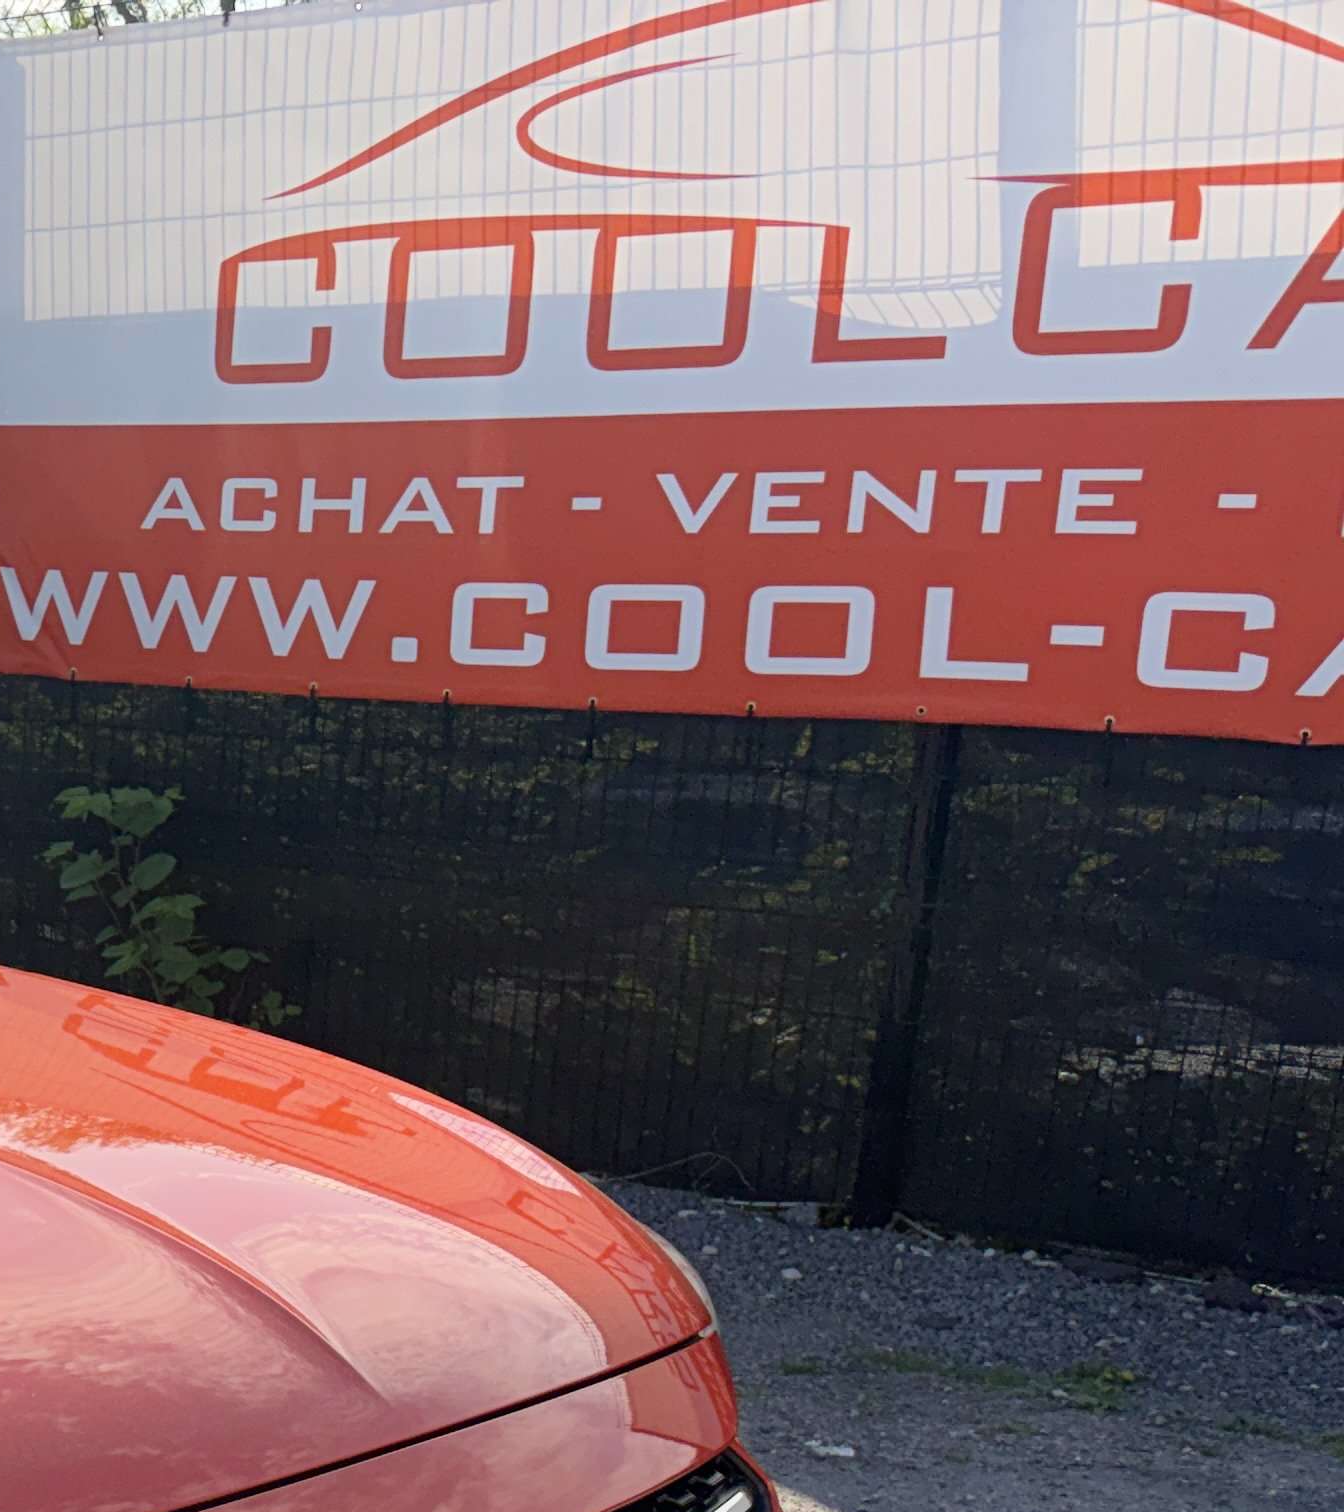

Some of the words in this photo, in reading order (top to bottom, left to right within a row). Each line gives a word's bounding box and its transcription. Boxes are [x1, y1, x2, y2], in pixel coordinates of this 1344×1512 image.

[214, 213, 947, 384] COOL
[140, 475, 524, 534] ACHAT
[656, 468, 1144, 535] VENTE
